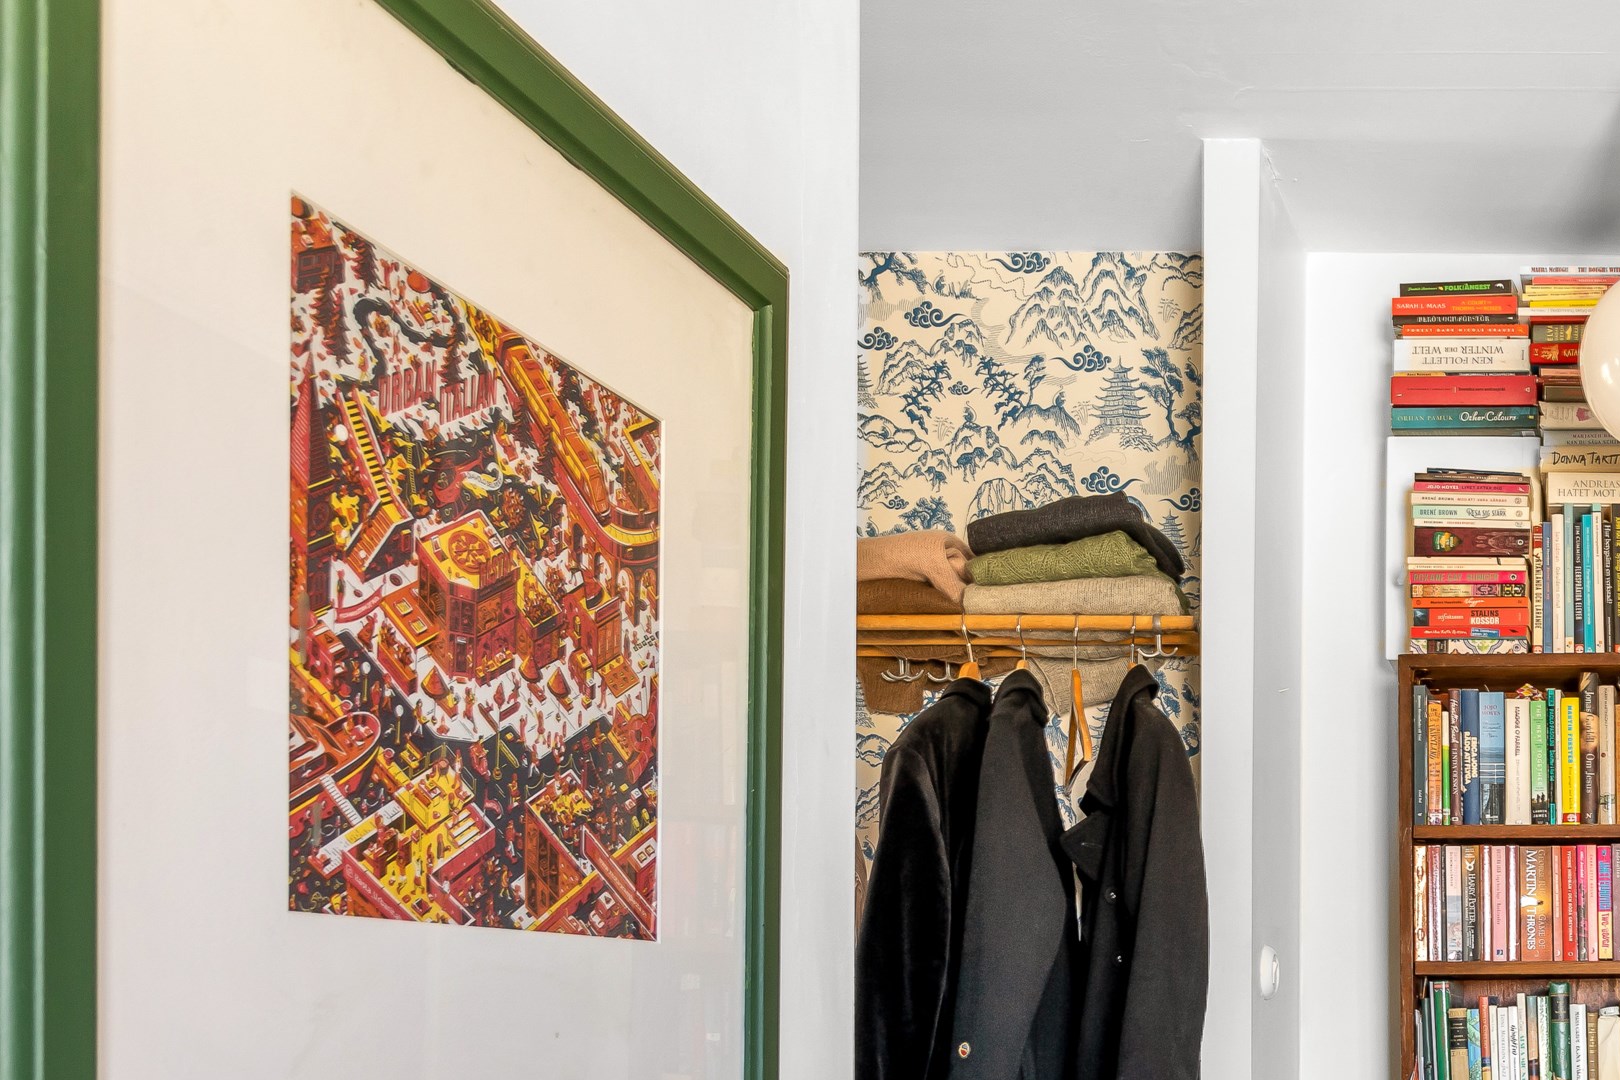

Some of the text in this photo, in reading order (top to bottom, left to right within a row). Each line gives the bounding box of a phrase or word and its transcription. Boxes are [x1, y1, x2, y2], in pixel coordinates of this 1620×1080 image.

[1412, 346, 1441, 355] WELT
[1422, 356, 1493, 365] KEN FOLLETT
[1461, 345, 1504, 354] WINTER
[379, 360, 438, 417] URBAN
[440, 368, 497, 425] ITALIAN
[1552, 452, 1587, 466] DONNA
[1557, 489, 1589, 497] HATET
[1593, 489, 1617, 497] MOT
[1572, 480, 1620, 489] ANDREAS
[1605, 569, 1611, 577] en
[1470, 617, 1500, 625] KOSSOR
[1575, 602, 1583, 621] ELEVER
[1585, 690, 1596, 743] Jonas Gardell
[1535, 750, 1543, 786] TOGETHER
[1585, 753, 1595, 794] Om Jesus
[1451, 770, 1459, 795] OLSSON
[1525, 850, 1537, 896] MARTIN
[1468, 873, 1477, 924] HARRY POTTER
[1526, 907, 1537, 949] THRONES
[1538, 914, 1546, 949] GAME OF
